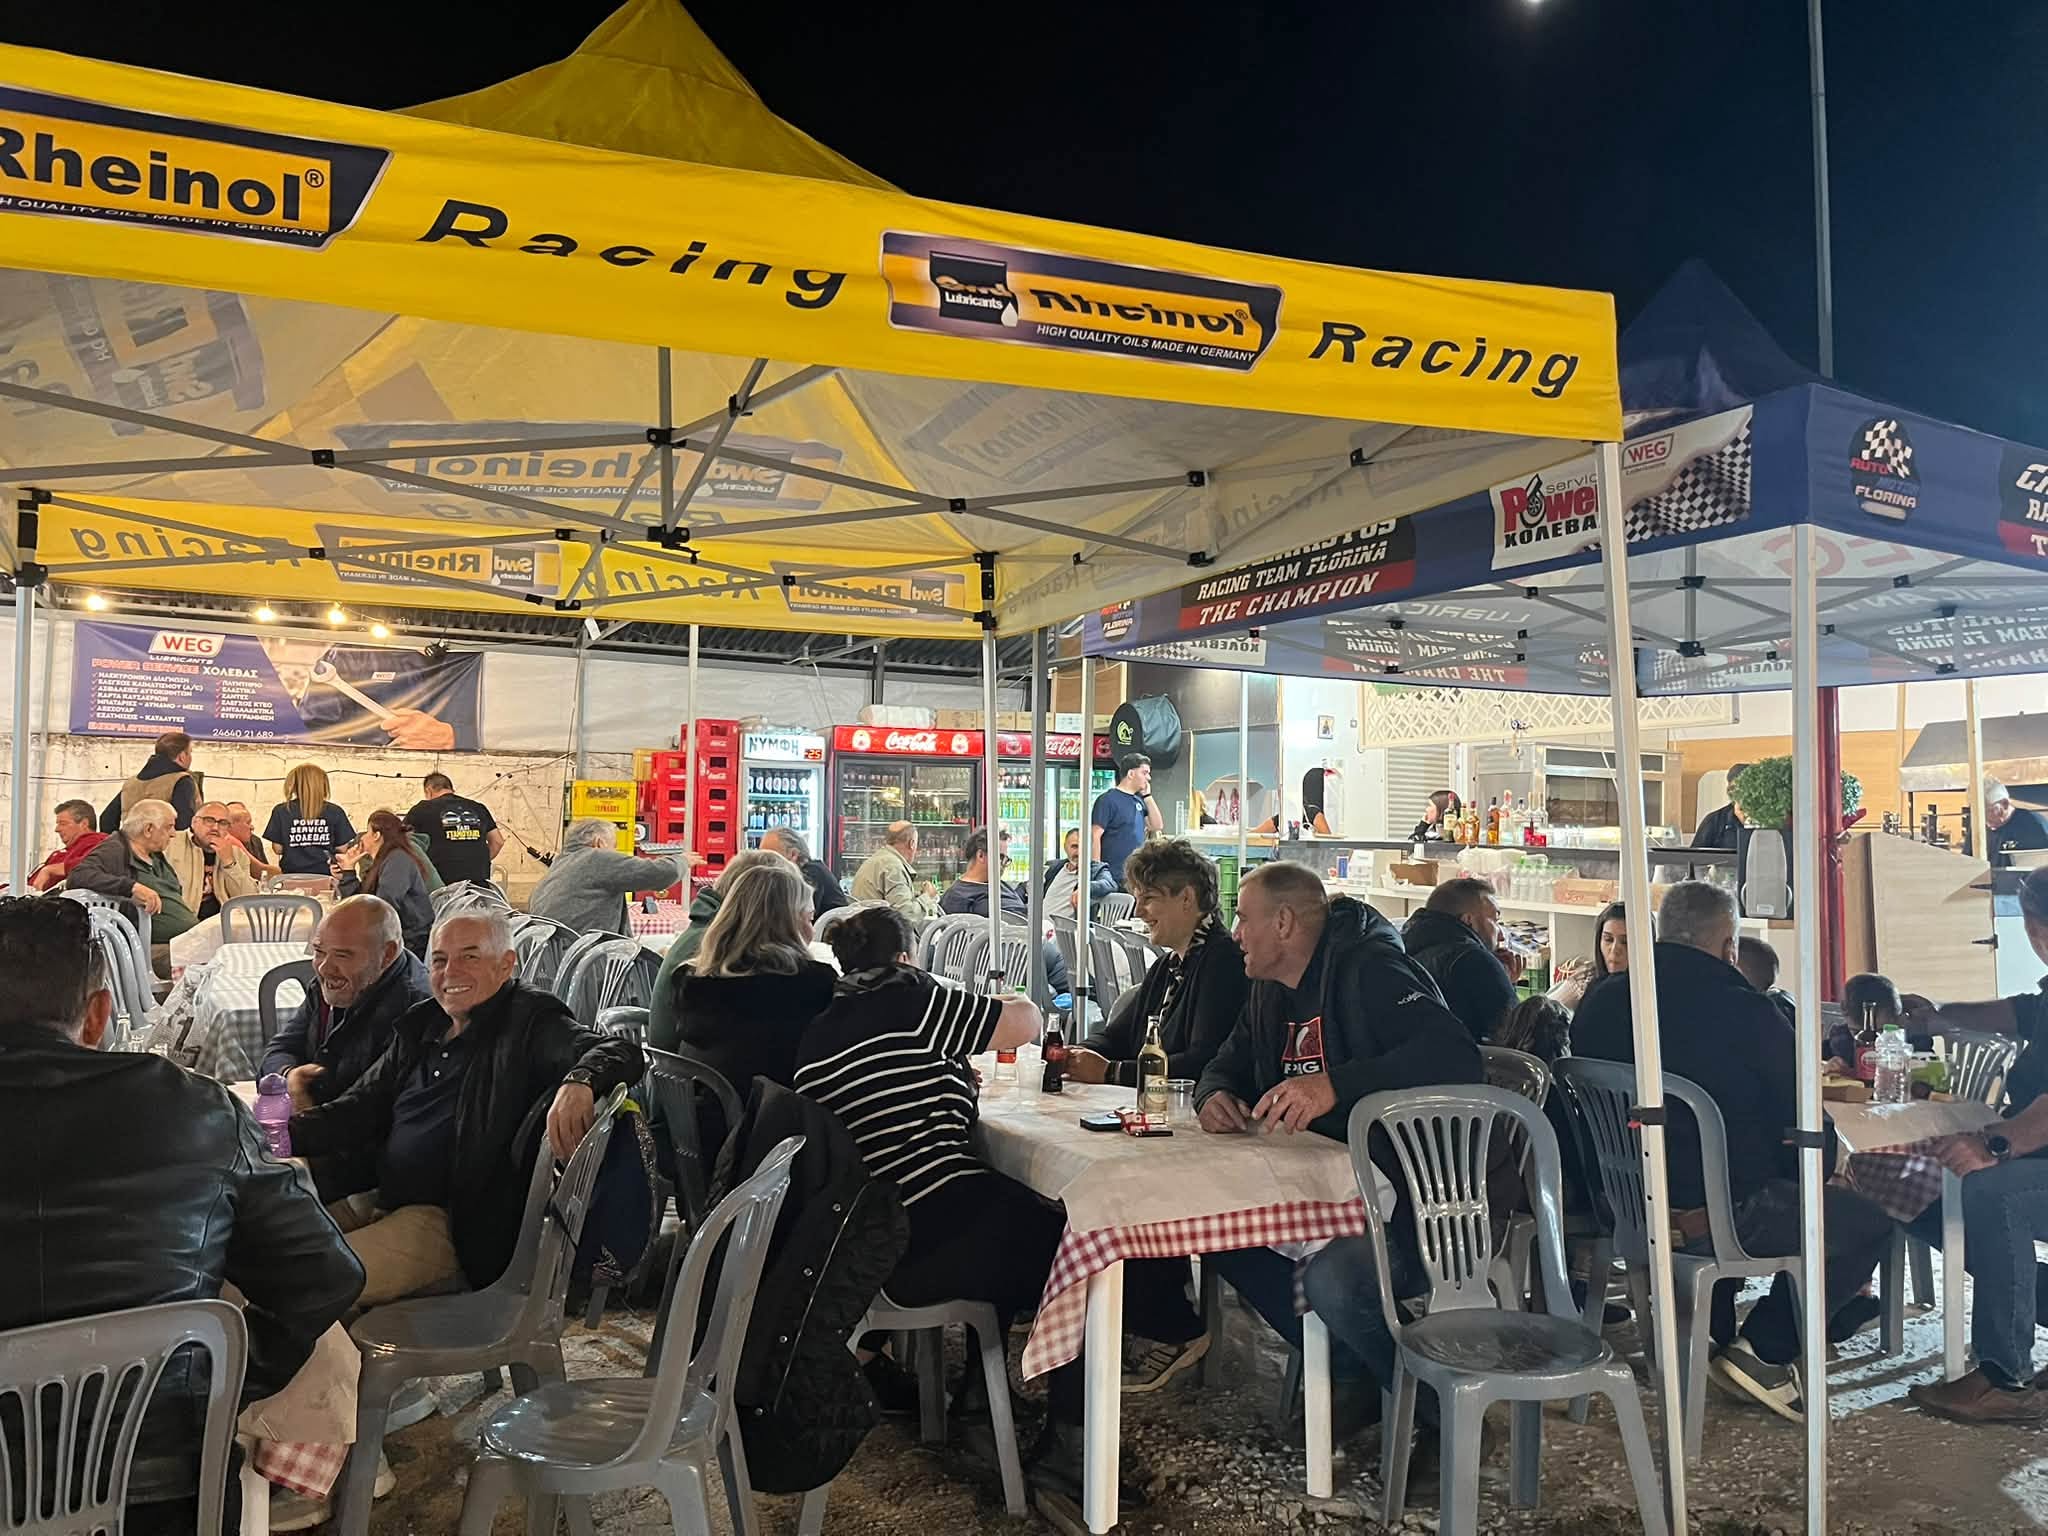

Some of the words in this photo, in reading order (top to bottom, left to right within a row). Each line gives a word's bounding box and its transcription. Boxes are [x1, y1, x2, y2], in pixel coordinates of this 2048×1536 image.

[18, 200, 100, 214] QUALITY
[105, 209, 147, 219] OILS
[153, 214, 206, 226] MADE
[212, 220, 229, 228] IN
[235, 222, 325, 239] GERMANY
[415, 199, 847, 309] Racing
[944, 291, 1004, 311] Lubricants
[1037, 324, 1067, 337] HIGH
[1069, 328, 1121, 344] QUALITY
[1122, 335, 1149, 348] OILS
[1151, 339, 1183, 353] MADE
[1186, 344, 1198, 354] IN
[1200, 346, 1255, 362] GERMANY
[1308, 321, 1579, 399] Racing
[1628, 441, 1666, 462] WEG
[1546, 474, 1598, 494] servic
[1855, 485, 1917, 508] FLORINA
[1197, 574, 1252, 600] RACING
[1256, 562, 1300, 588] TEAM
[1306, 541, 1389, 577] FLORINA
[1200, 601, 1241, 625] THE
[1246, 572, 1379, 617] CHAMPION
[1103, 617, 1134, 631] FLORINA
[163, 635, 213, 653] WEG
[203, 666, 258, 678] ΧΟΛΕΒΑΣ
[212, 728, 242, 737] 24640
[256, 731, 274, 739] 689
